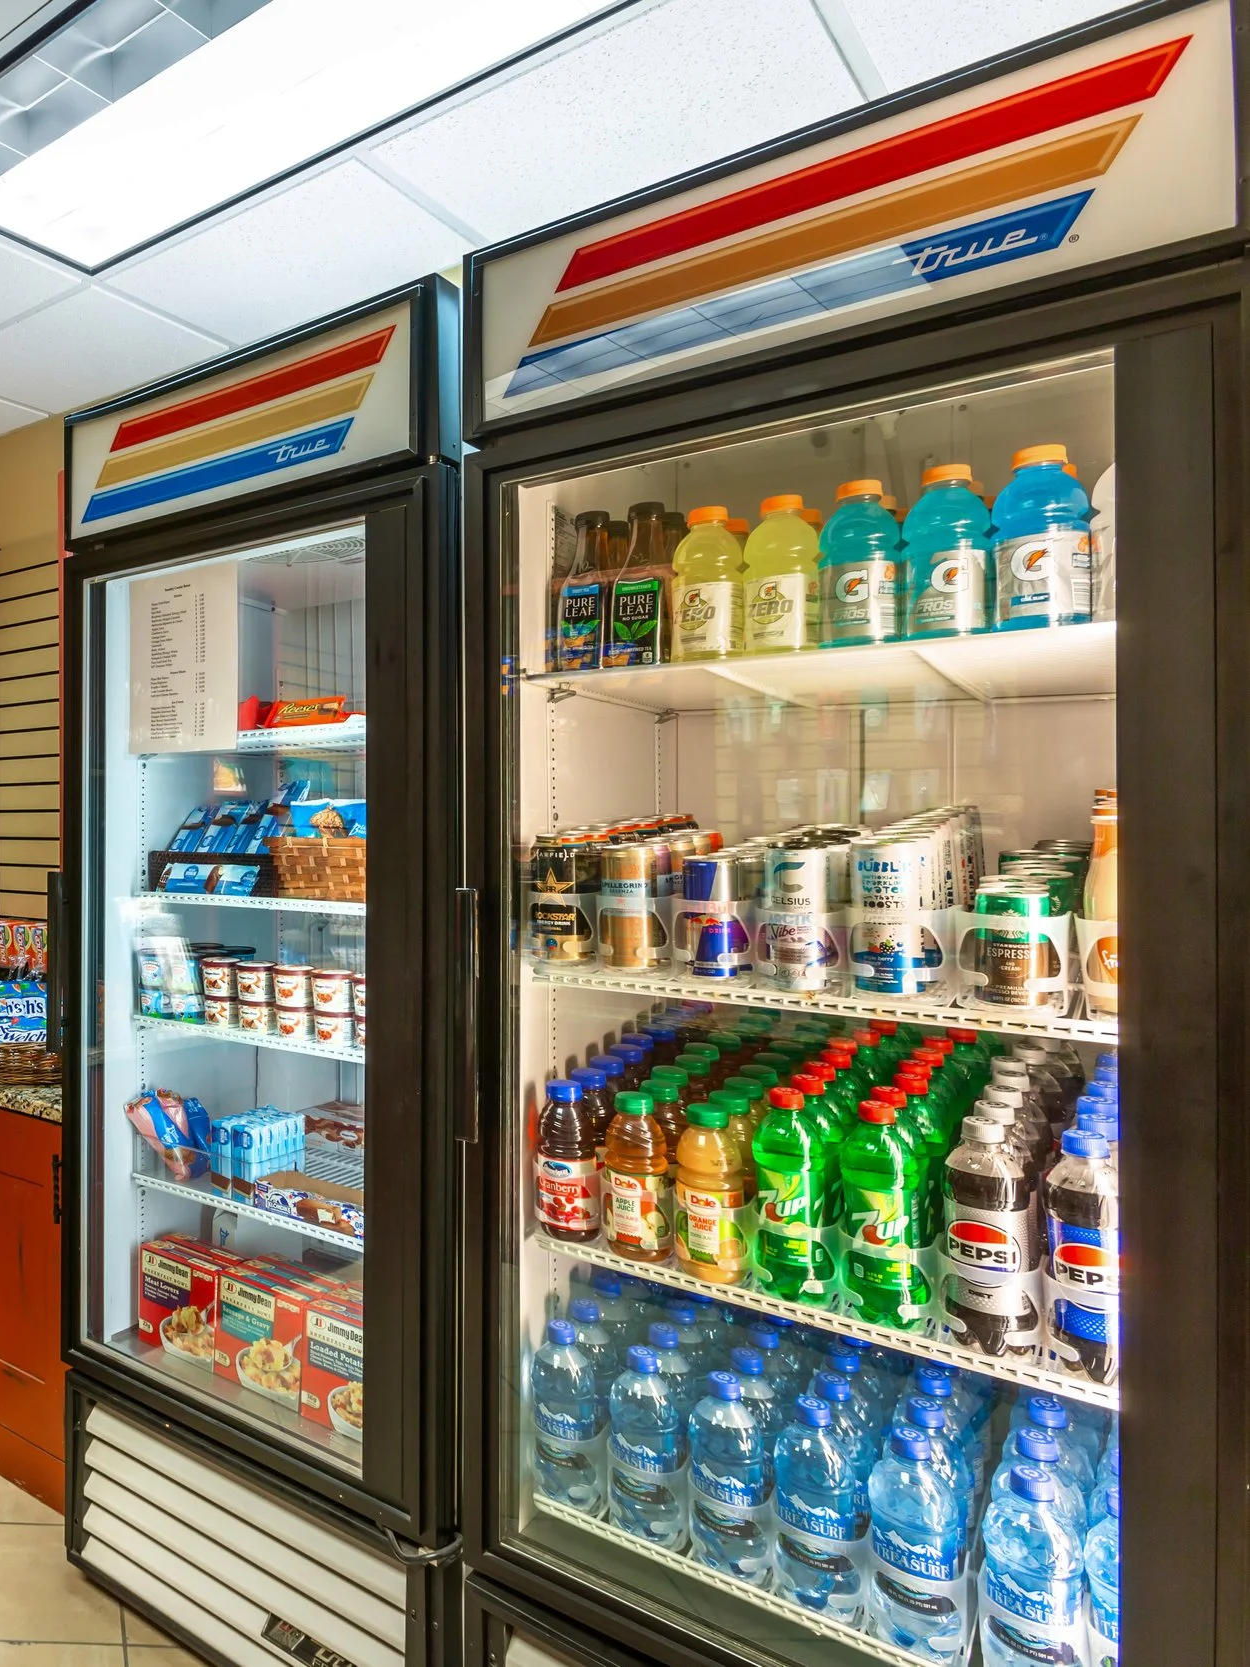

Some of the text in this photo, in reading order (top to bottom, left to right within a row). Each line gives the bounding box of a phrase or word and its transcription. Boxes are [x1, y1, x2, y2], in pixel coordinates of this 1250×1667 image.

[892, 229, 1038, 276] true
[269, 438, 330, 464] true
[931, 558, 969, 593] G
[835, 569, 869, 603] G
[566, 596, 595, 608] PURE
[619, 593, 654, 606] PURE
[917, 600, 956, 613] FROS
[748, 600, 794, 618] ZERO
[770, 895, 811, 906] CELSIUS
[771, 924, 796, 939] Vibe
[986, 947, 1030, 960] ESPRESS
[540, 1176, 581, 1196] Cranberry
[614, 1177, 637, 1189] Dole
[615, 1198, 635, 1207] APPLE
[616, 1204, 635, 1212] JUICE
[691, 1195, 716, 1207] Dole
[689, 1215, 717, 1226] ORANGE
[692, 1223, 713, 1232] JUICE
[948, 1238, 1017, 1265] PEPSI
[158, 1260, 189, 1279] Jimmy Dean
[145, 1275, 159, 1287] Meat
[160, 1281, 180, 1295] Lovers
[174, 1278, 188, 1288] BOWL
[238, 1287, 272, 1308] Jimmy Dean
[968, 1288, 993, 1299] DIET
[223, 1305, 245, 1320] Sausage
[251, 1318, 270, 1331] Gravy
[328, 1323, 363, 1344] Jimmy Dea
[310, 1341, 339, 1358] Loaded
[348, 1344, 363, 1354] BOW
[875, 1541, 950, 1580] TREASURE
[987, 1583, 1071, 1626] TREASU
